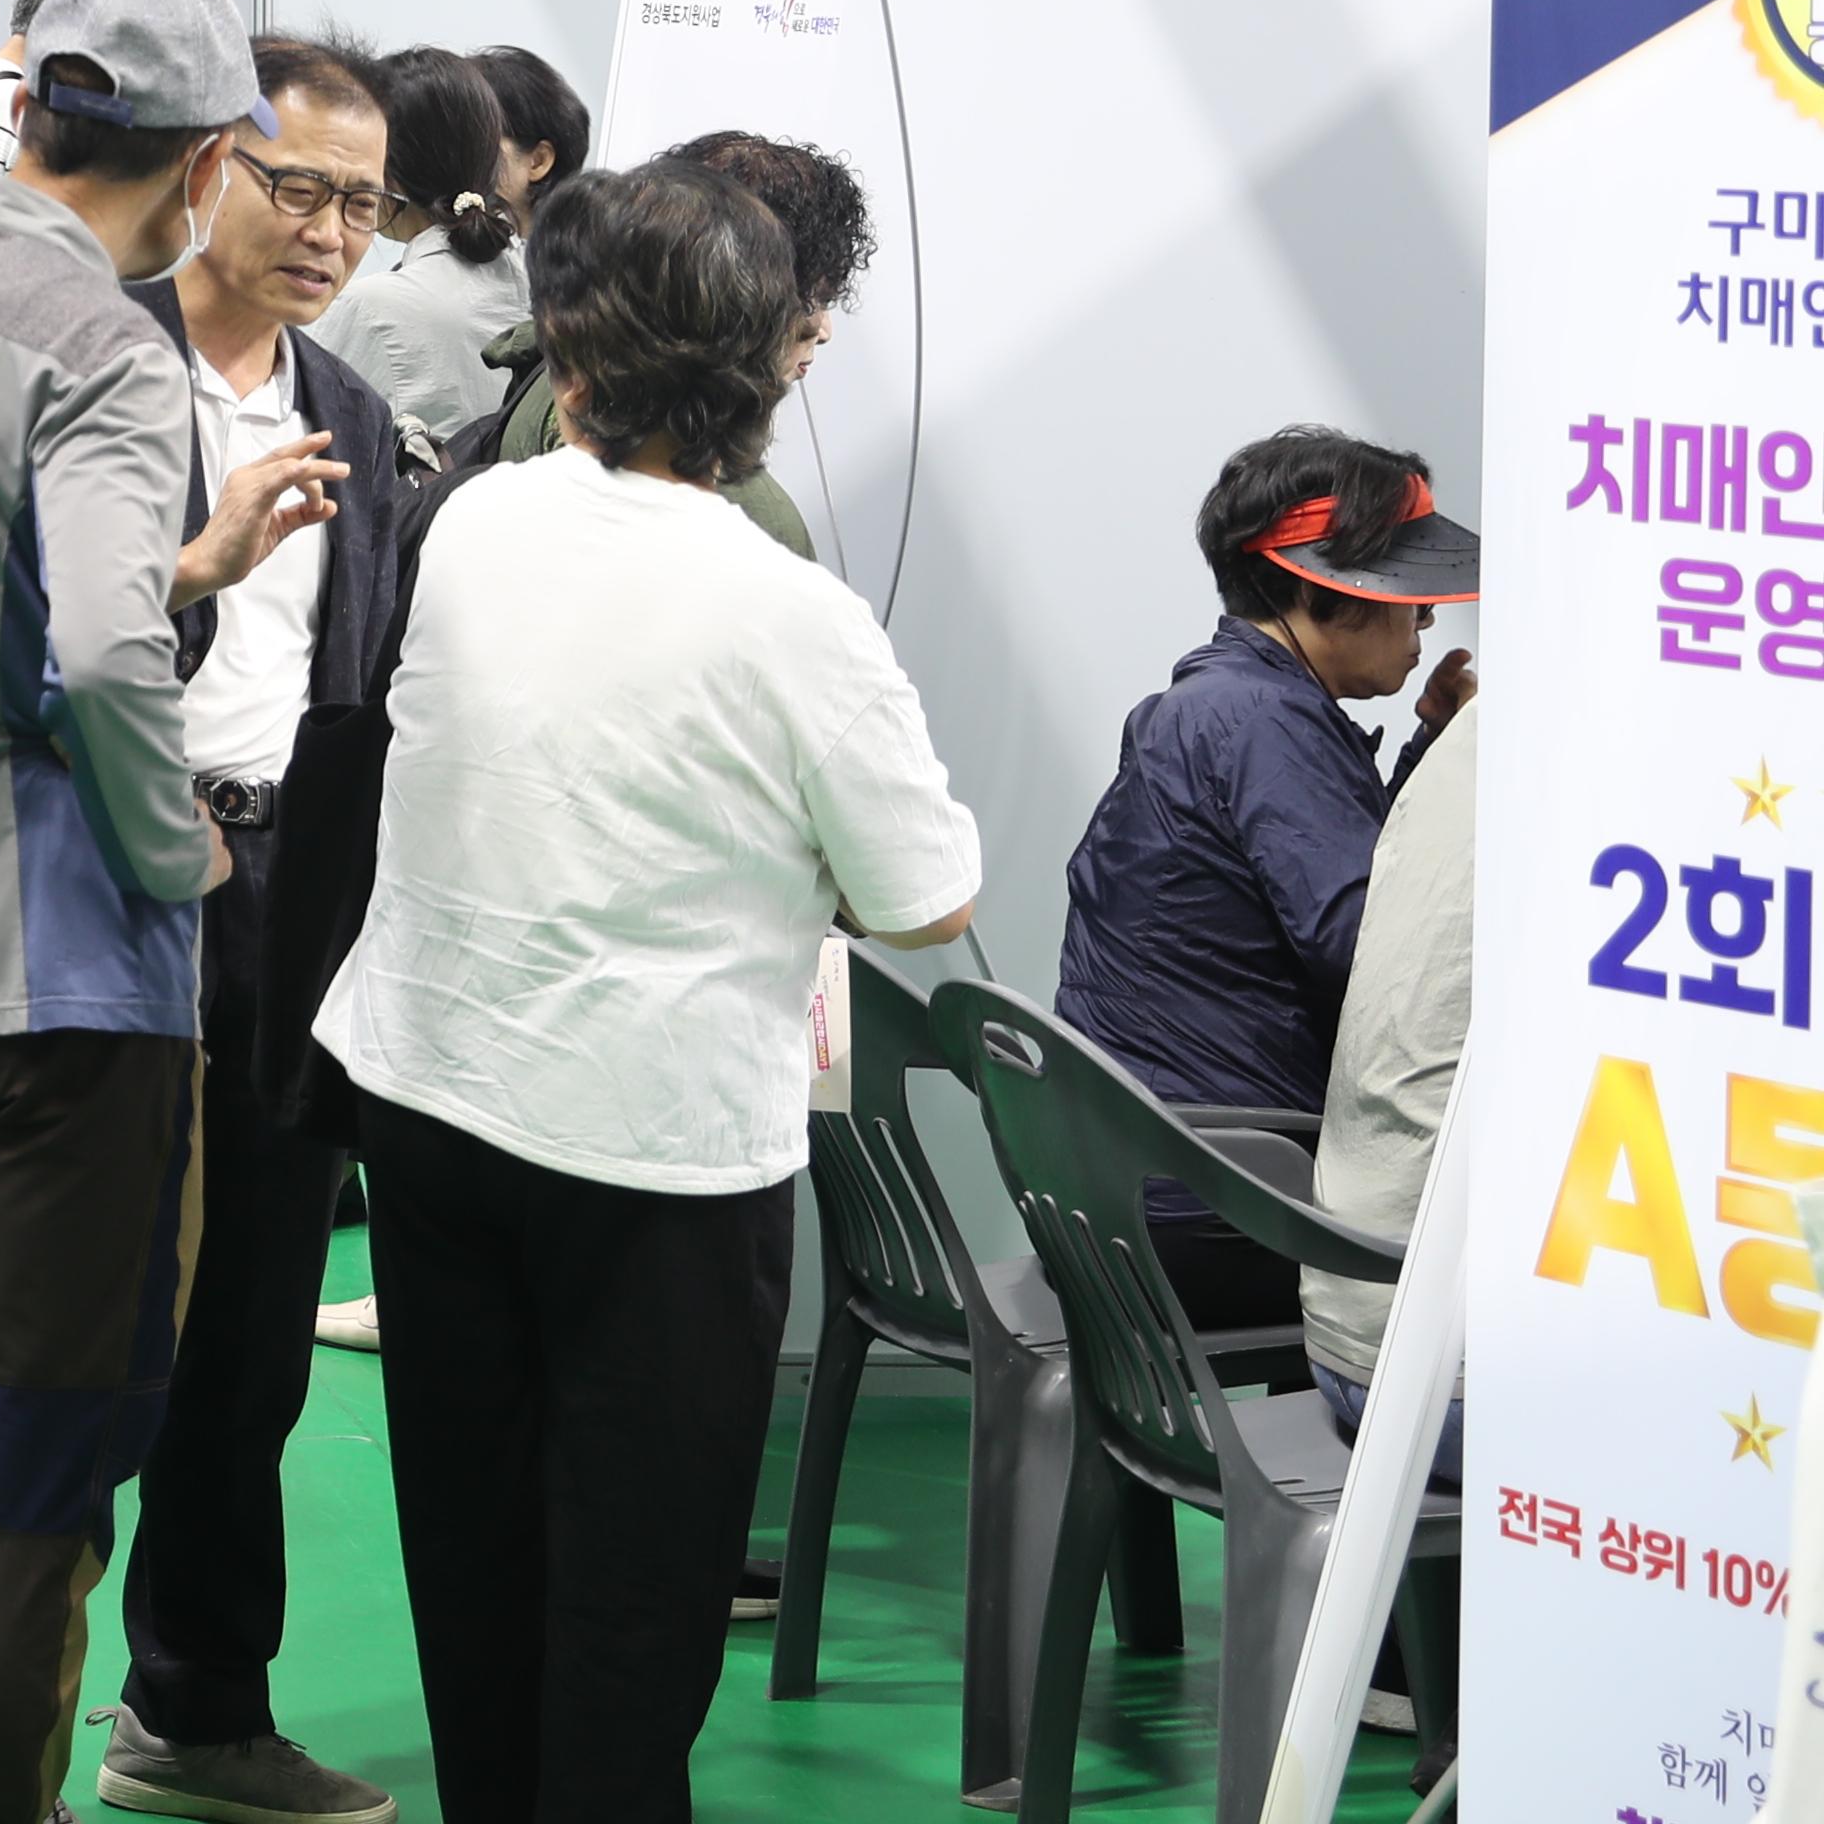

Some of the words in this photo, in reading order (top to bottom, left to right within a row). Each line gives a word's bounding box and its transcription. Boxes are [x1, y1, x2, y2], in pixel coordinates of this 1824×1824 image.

[641, 1, 721, 28] 경상북도지원사업
[1588, 843, 1813, 1031] 2회
[1498, 1485, 1582, 1559] 전국
[1598, 1516, 1685, 1591] 상위
[1702, 1548, 1791, 1619] 10%
[1657, 1742, 1727, 1806] 함께
